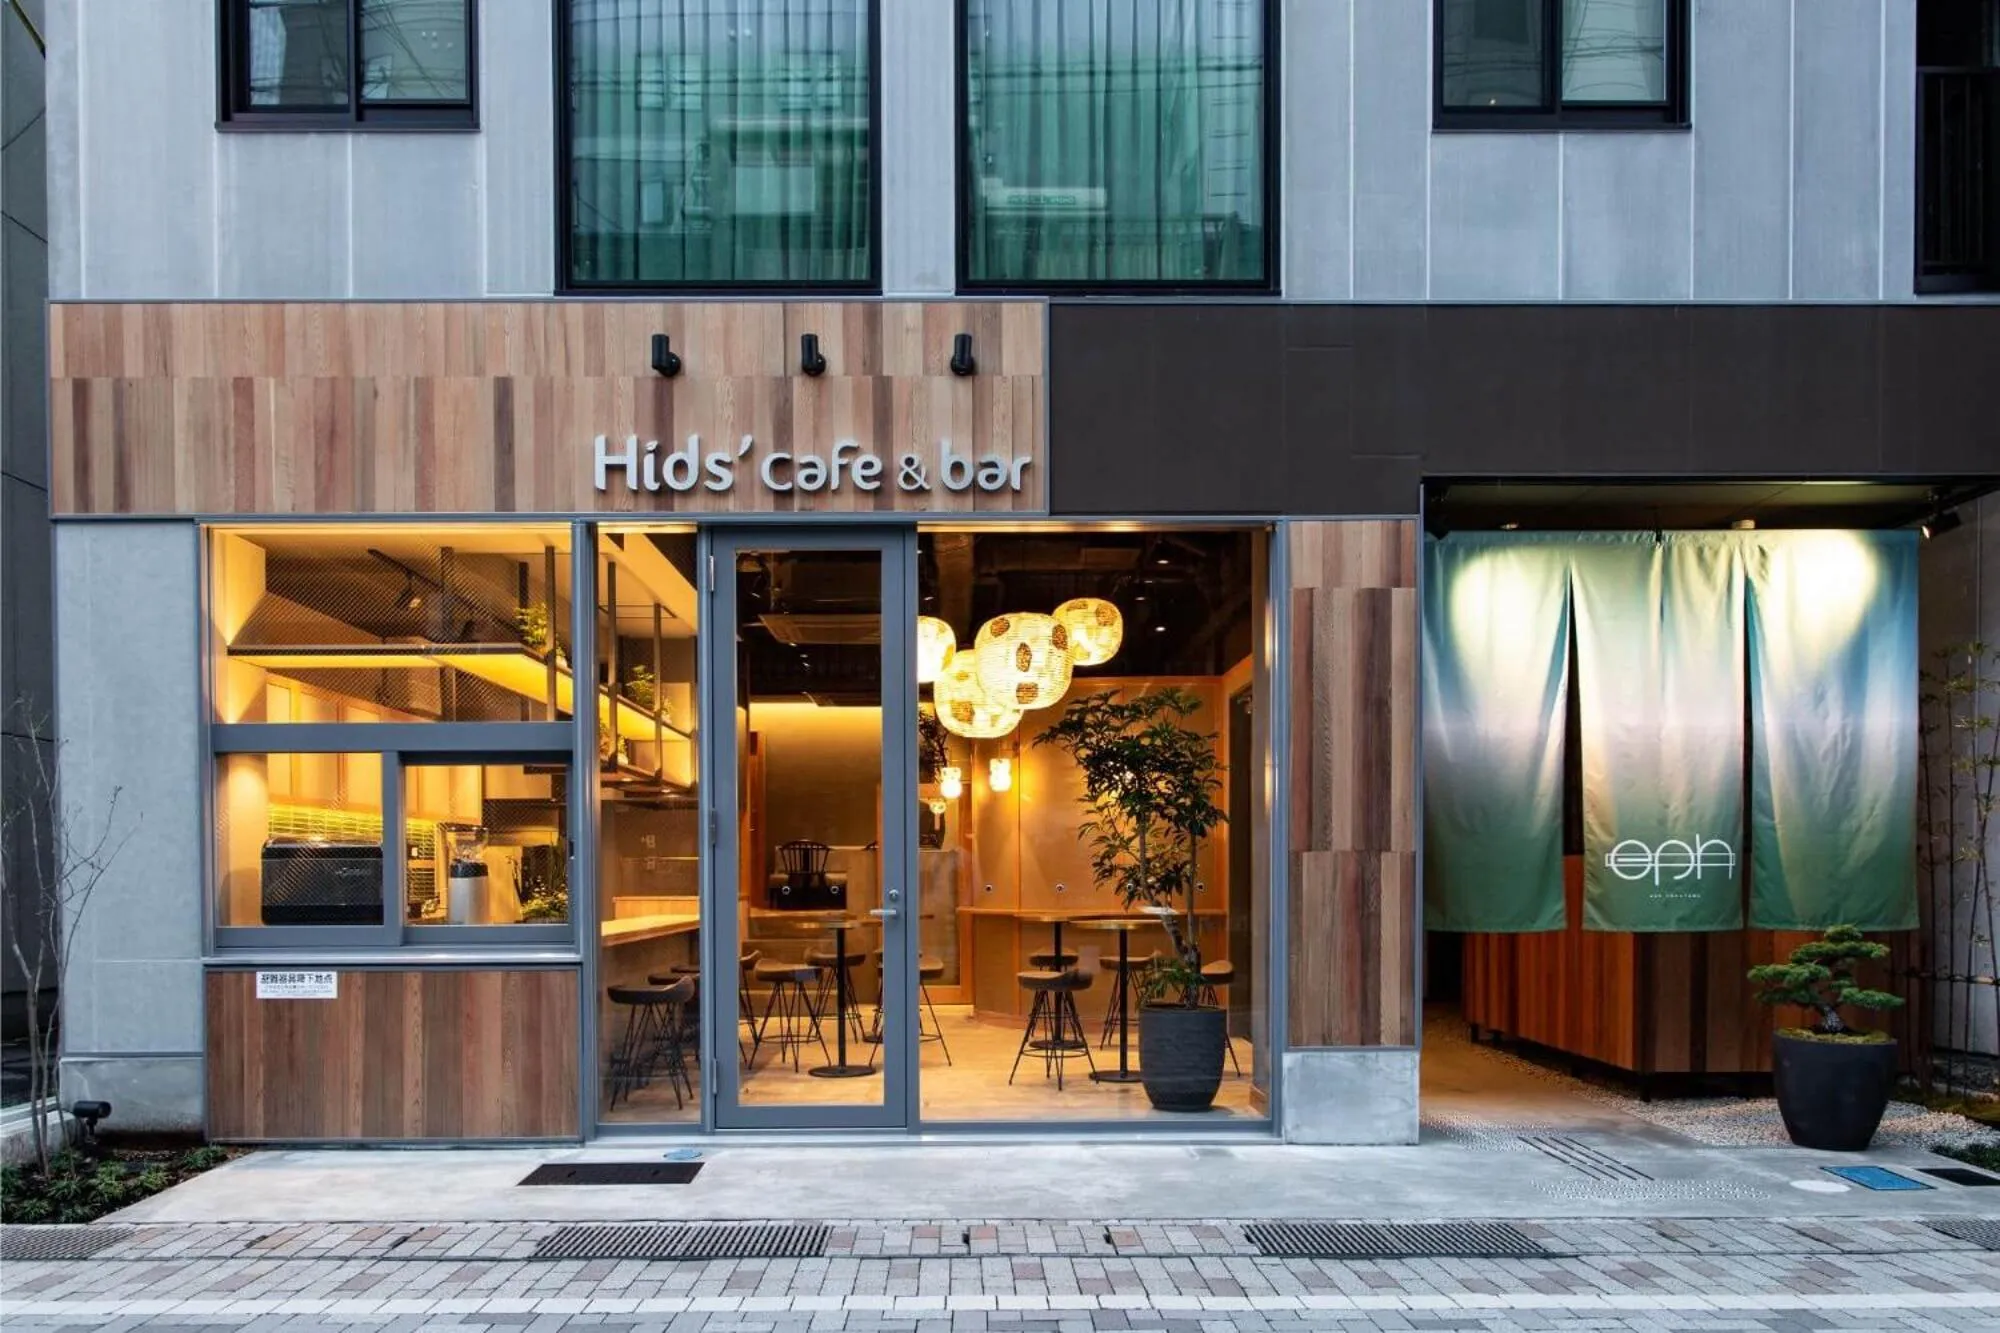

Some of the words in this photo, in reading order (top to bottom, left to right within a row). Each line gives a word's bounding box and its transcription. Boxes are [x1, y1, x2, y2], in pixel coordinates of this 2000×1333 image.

[594, 434, 752, 492] Hids'
[761, 438, 883, 492] cafe
[897, 454, 931, 491] &
[940, 437, 1032, 492] bar
